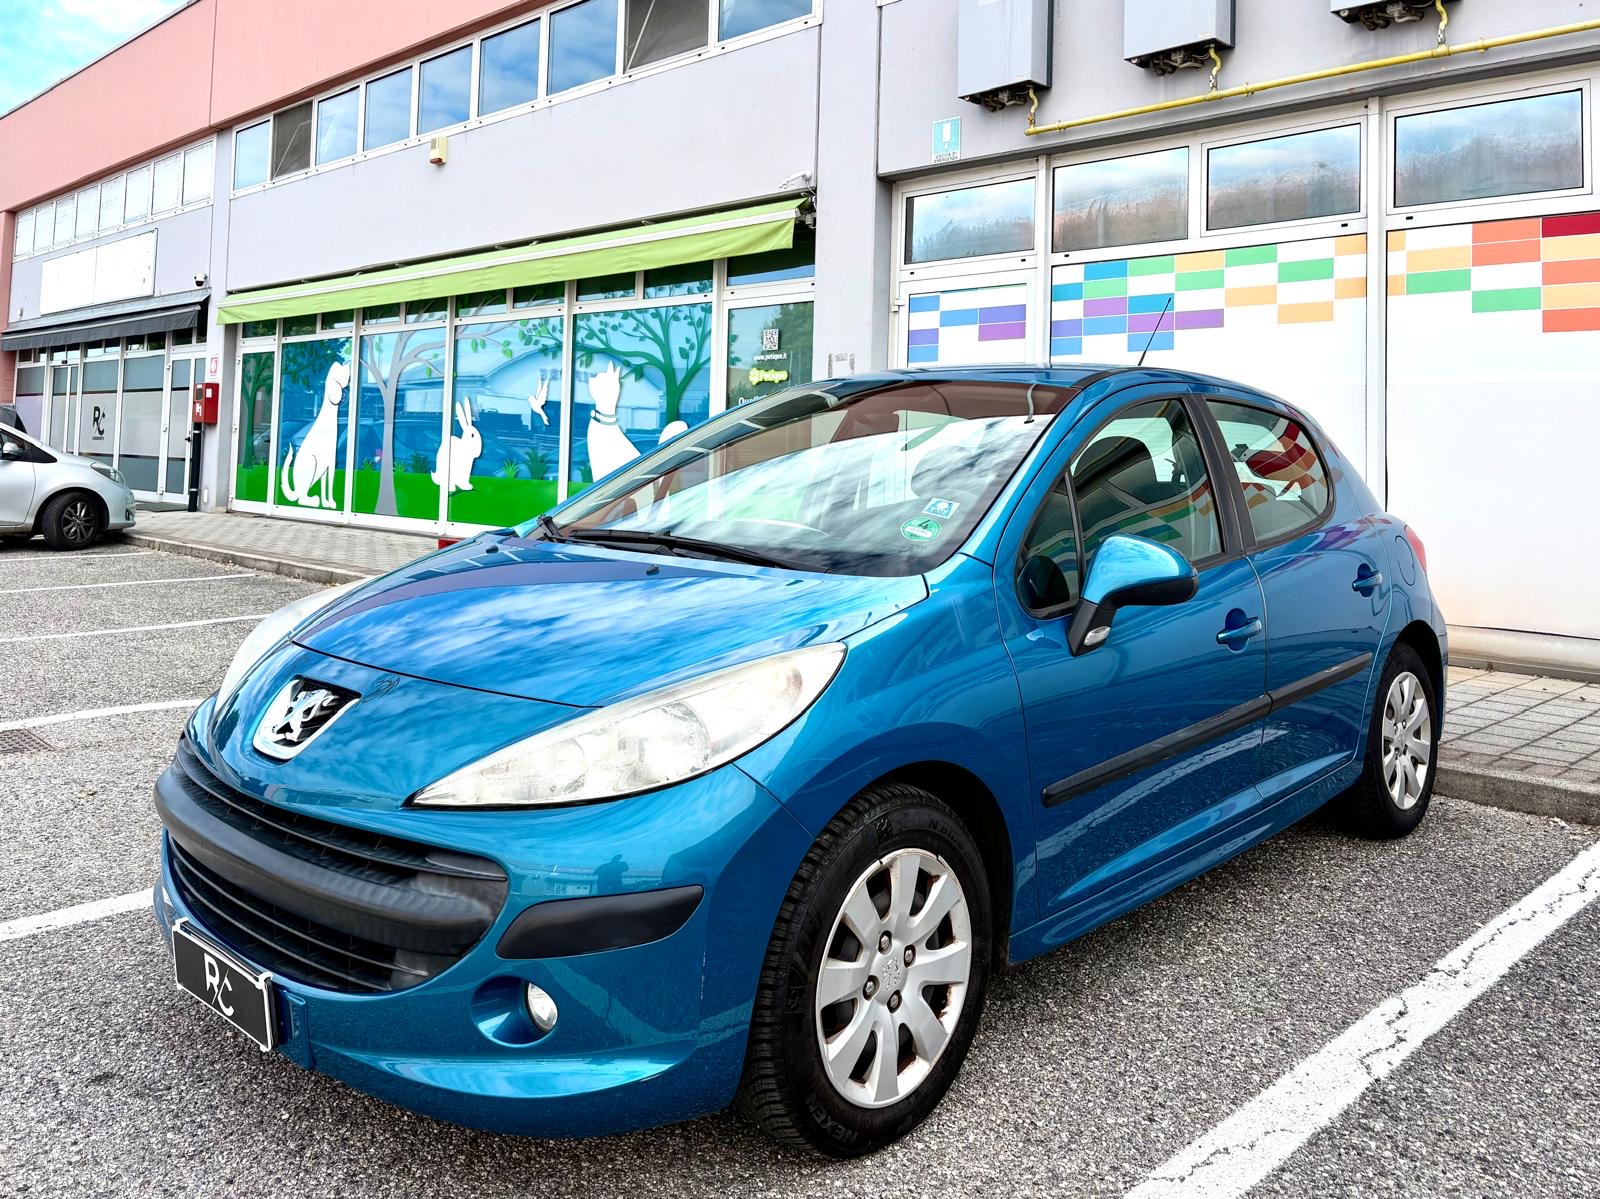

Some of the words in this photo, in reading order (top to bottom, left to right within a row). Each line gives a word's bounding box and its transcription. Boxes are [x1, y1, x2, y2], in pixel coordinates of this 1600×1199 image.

[753, 352, 788, 361] www.petique.it
[759, 370, 788, 382] Petique
[917, 519, 931, 530] 4
